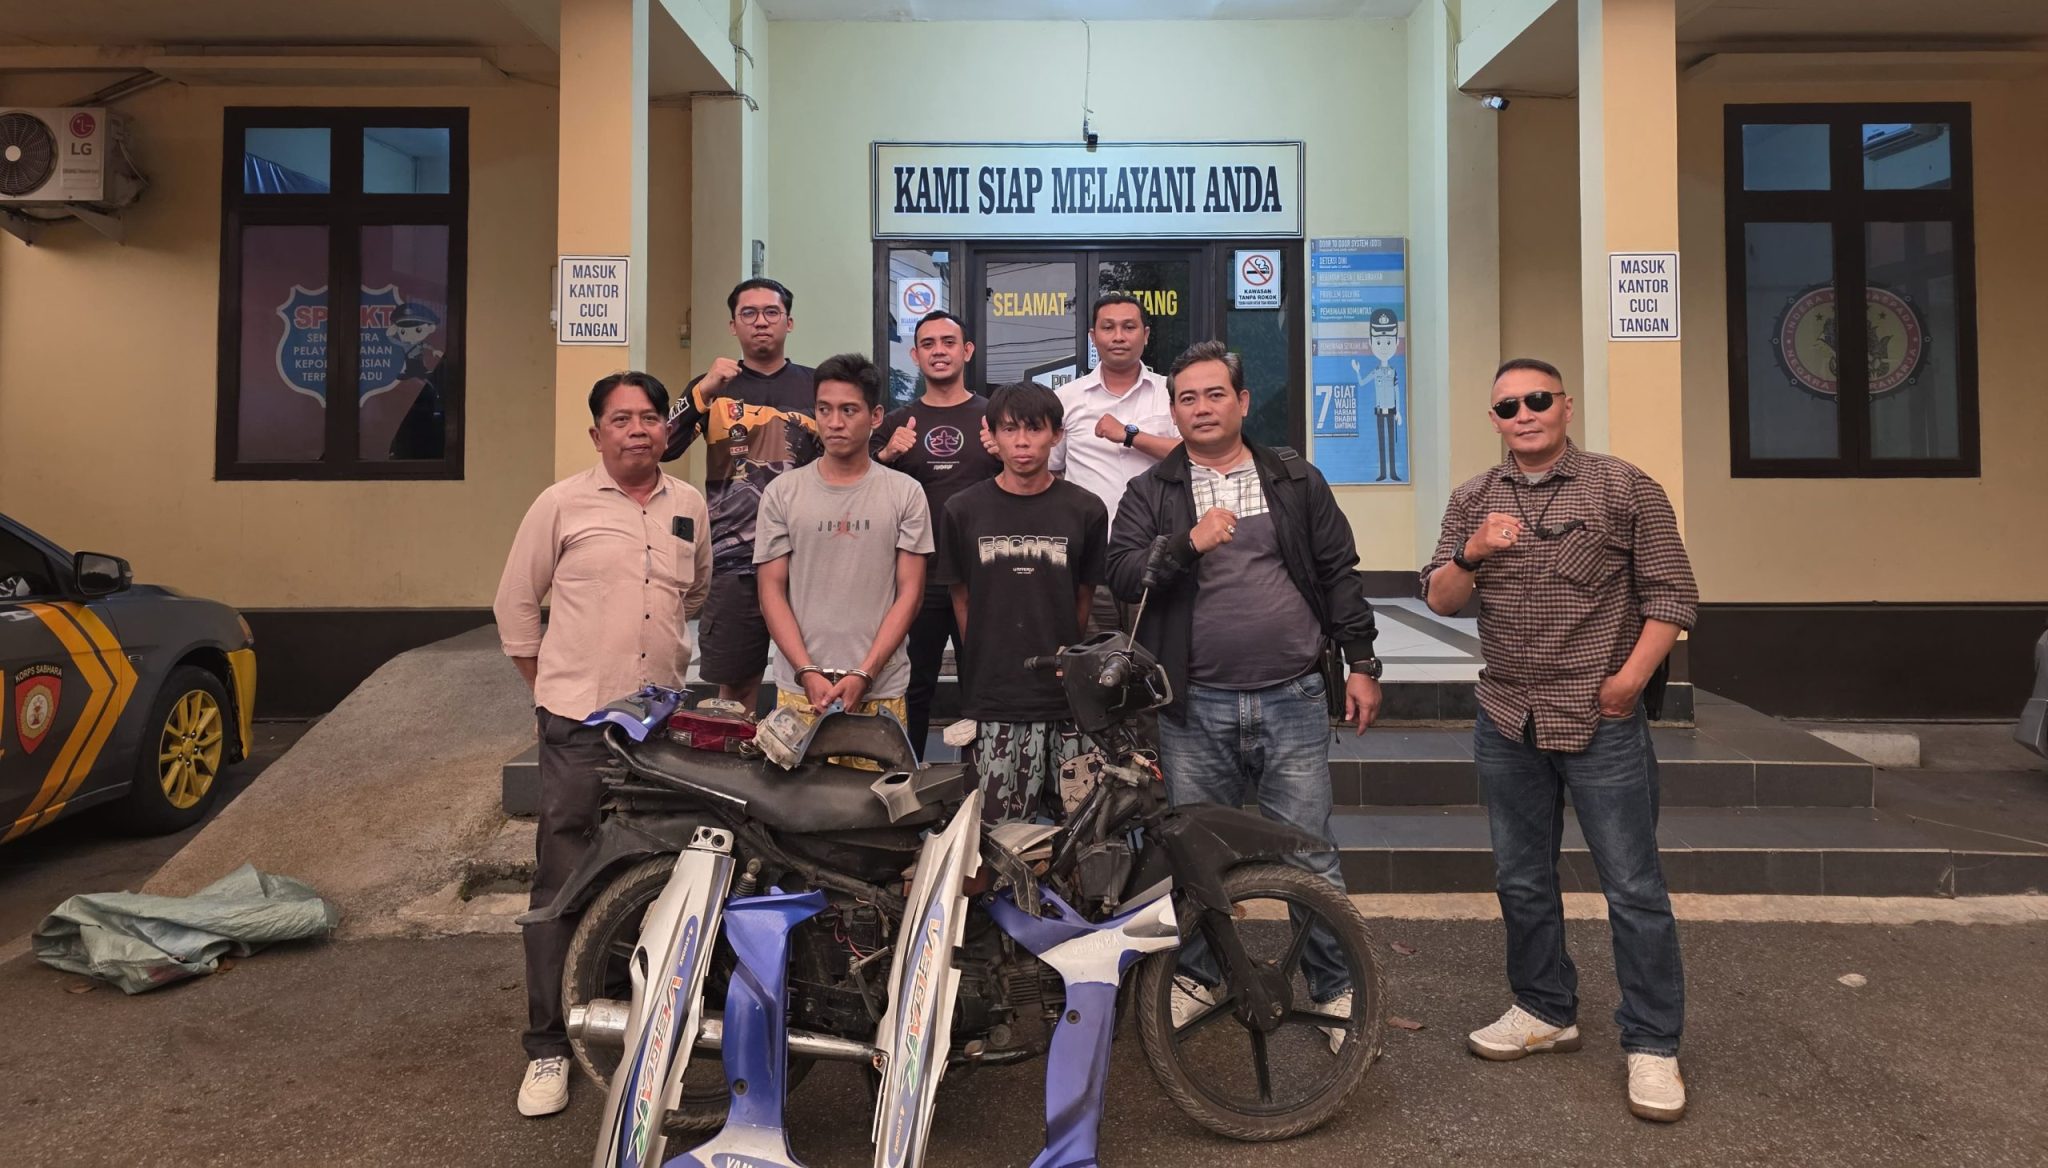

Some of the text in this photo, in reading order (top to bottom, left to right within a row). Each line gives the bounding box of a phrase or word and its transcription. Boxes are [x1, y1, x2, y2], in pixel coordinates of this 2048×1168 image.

[71, 143, 92, 155] LG
[894, 166, 1282, 215] KAMI SIAP MELAYANI ANDA
[572, 265, 617, 279] MASUK
[1620, 260, 1666, 274] MASUK
[569, 284, 619, 298] KANTOR
[1618, 279, 1669, 293] KANTOR
[992, 290, 1178, 316] SELAMAT TANG
[1630, 299, 1658, 313] CUCI
[580, 304, 608, 318] CUCI
[568, 323, 618, 337] TANGAN
[1618, 318, 1669, 332] TANGAN
[1315, 385, 1356, 429] 7 GIAT
[1334, 398, 1357, 409] WAJIB
[15, 664, 62, 683] KORPS SABHARA
